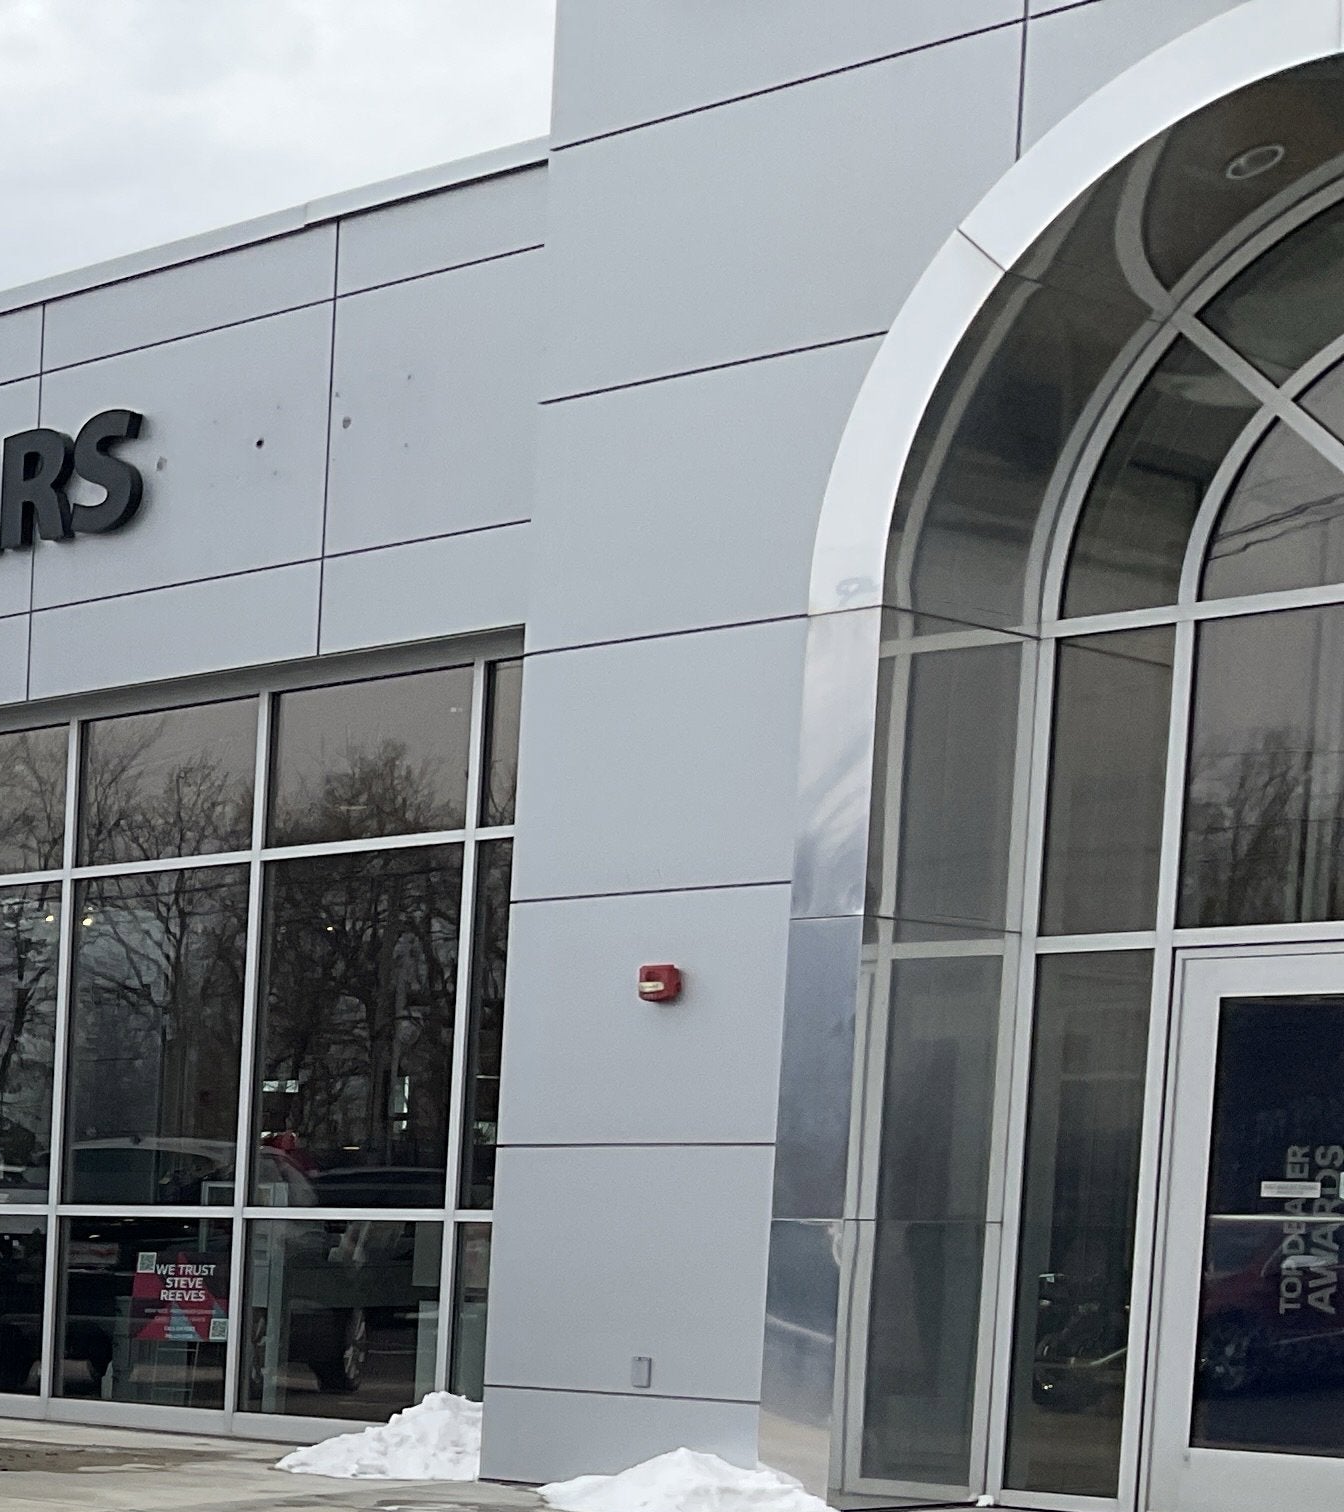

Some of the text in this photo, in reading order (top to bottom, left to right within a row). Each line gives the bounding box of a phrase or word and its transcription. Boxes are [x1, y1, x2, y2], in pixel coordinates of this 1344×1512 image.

[1282, 1145, 1310, 1255] DEAER
[1308, 1145, 1344, 1315] AWARDS
[156, 1264, 216, 1275] WE TRUST
[166, 1277, 203, 1288] STEVE
[160, 1290, 205, 1301] REEVES
